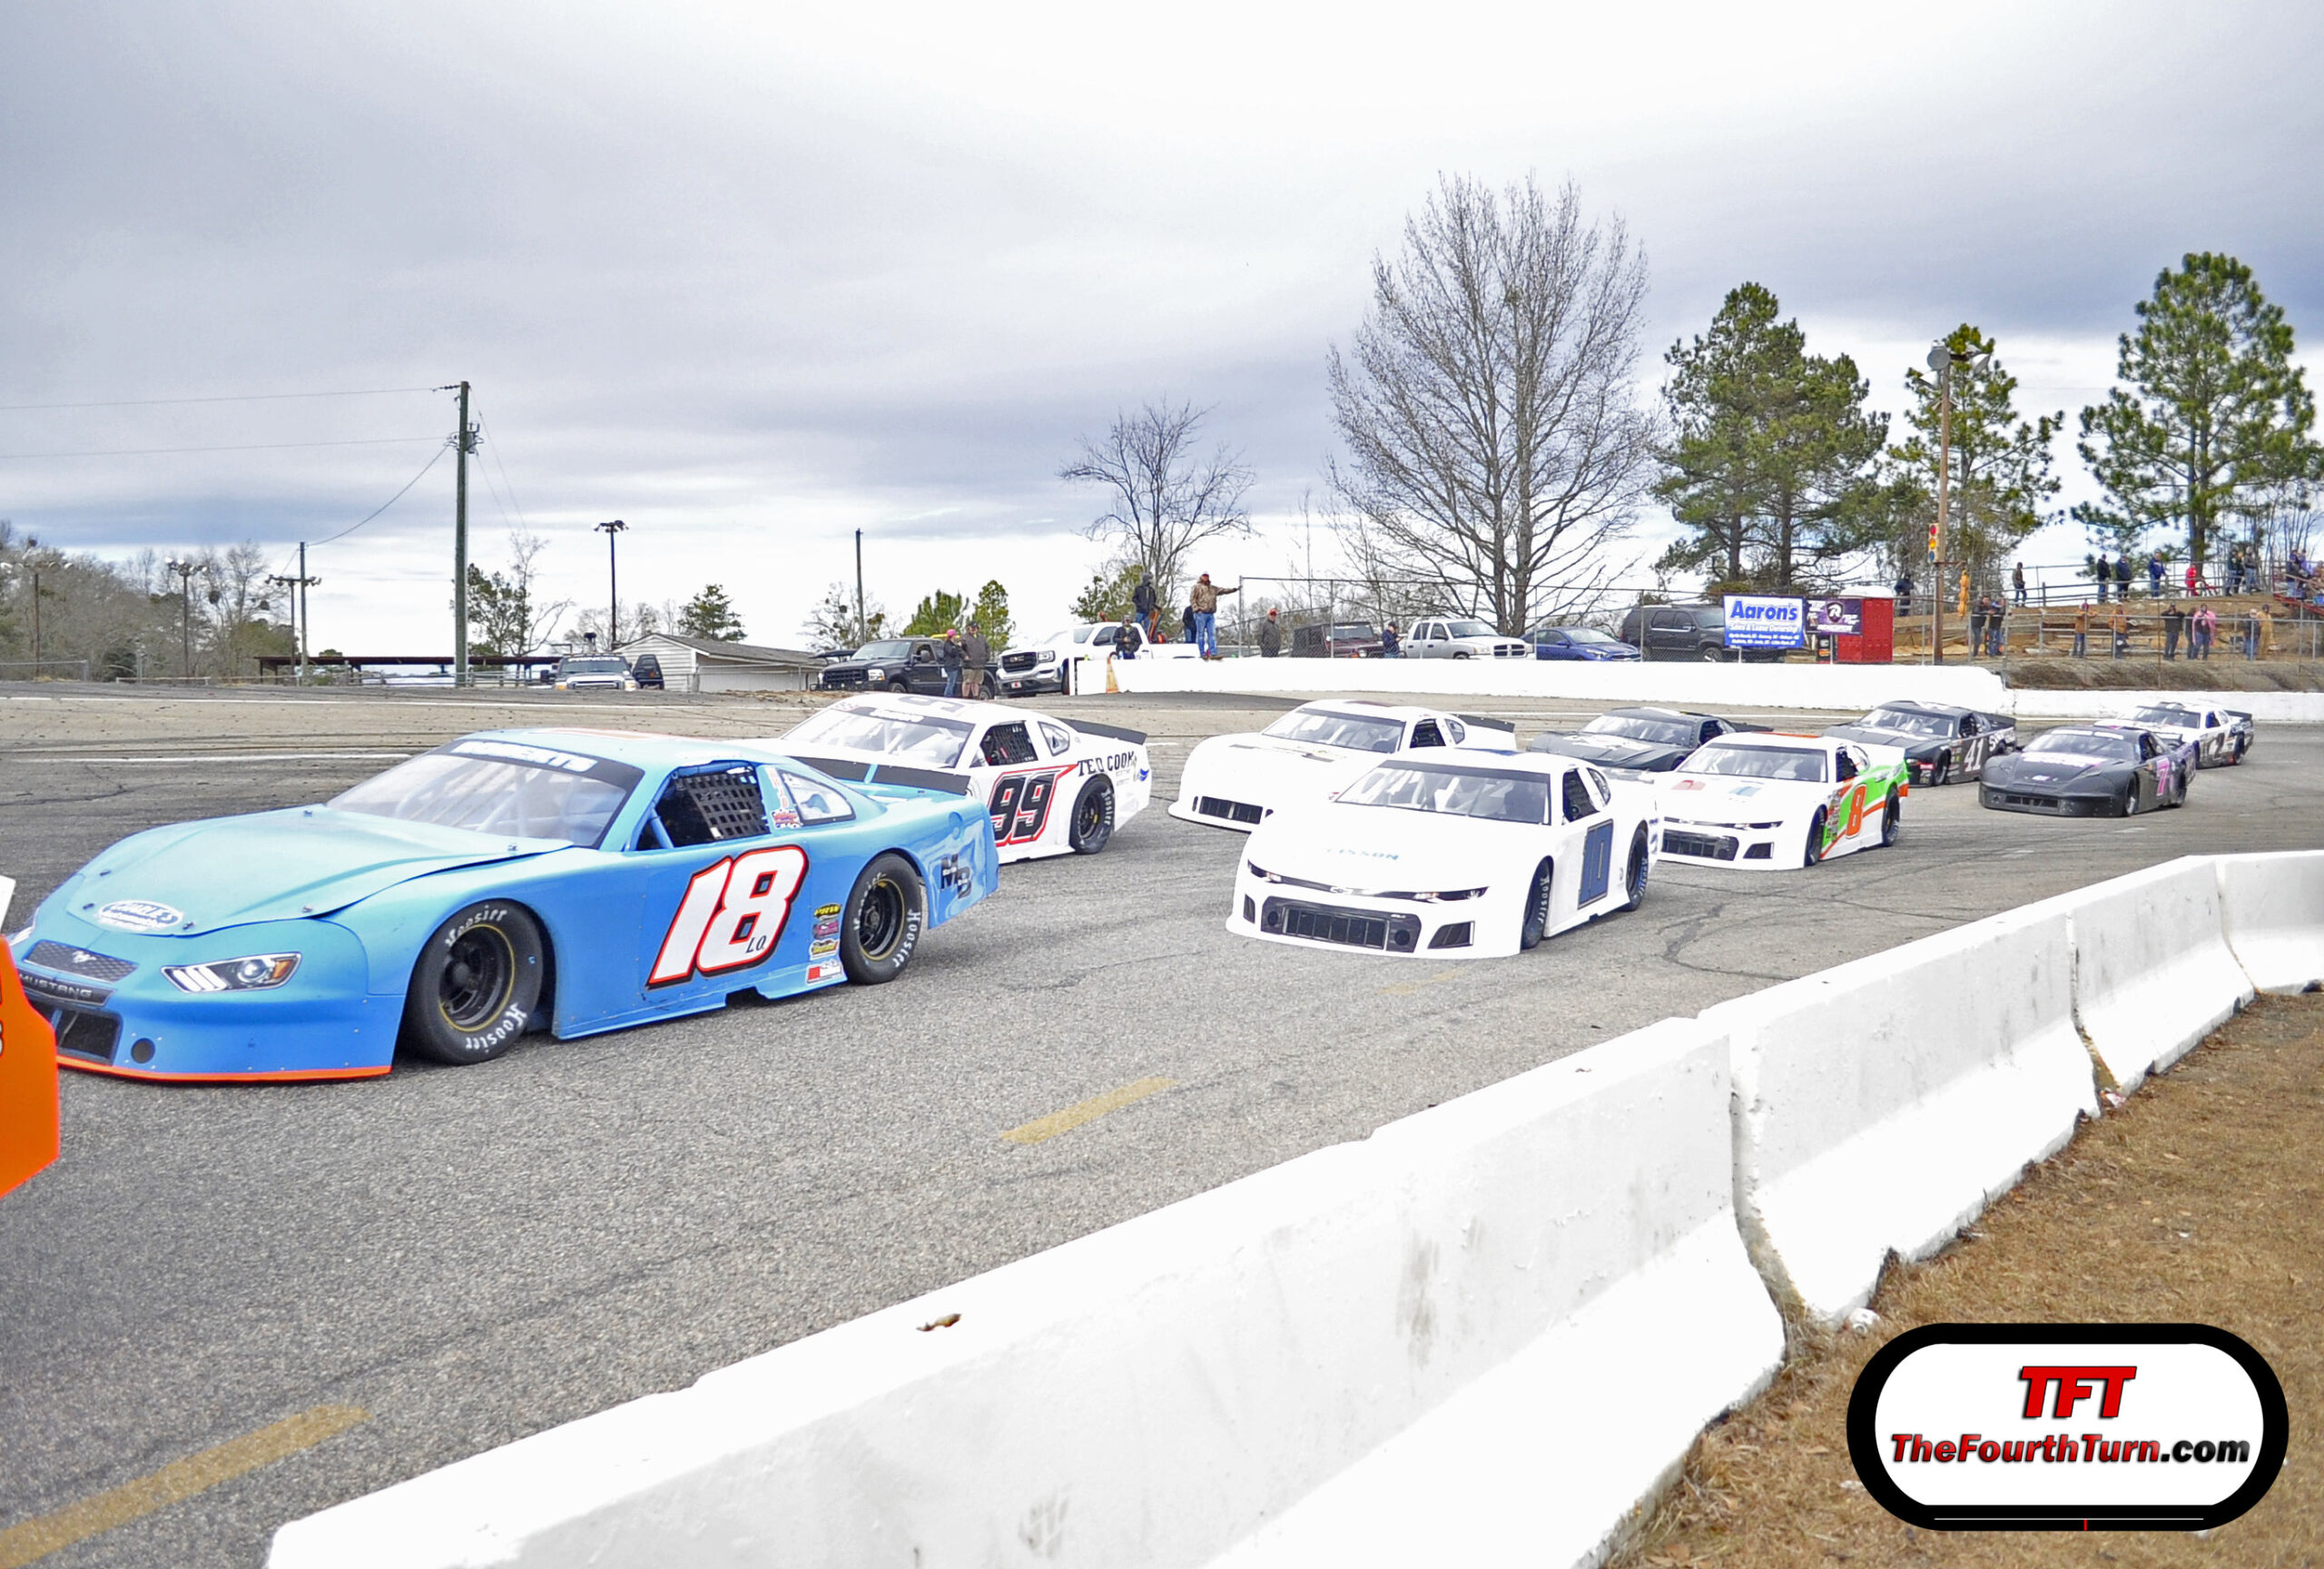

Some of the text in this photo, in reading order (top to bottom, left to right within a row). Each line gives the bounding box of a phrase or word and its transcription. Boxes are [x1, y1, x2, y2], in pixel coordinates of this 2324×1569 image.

[1730, 600, 1797, 621] Aaron's
[1964, 738, 1984, 772] 41
[2155, 757, 2171, 797] 7
[988, 772, 1059, 846] 99
[1846, 783, 1867, 839] 8
[645, 844, 810, 991] 18
[892, 909, 921, 968] Hoosier
[18, 972, 93, 998] MUSTANG
[466, 1002, 527, 1053] Hoosier
